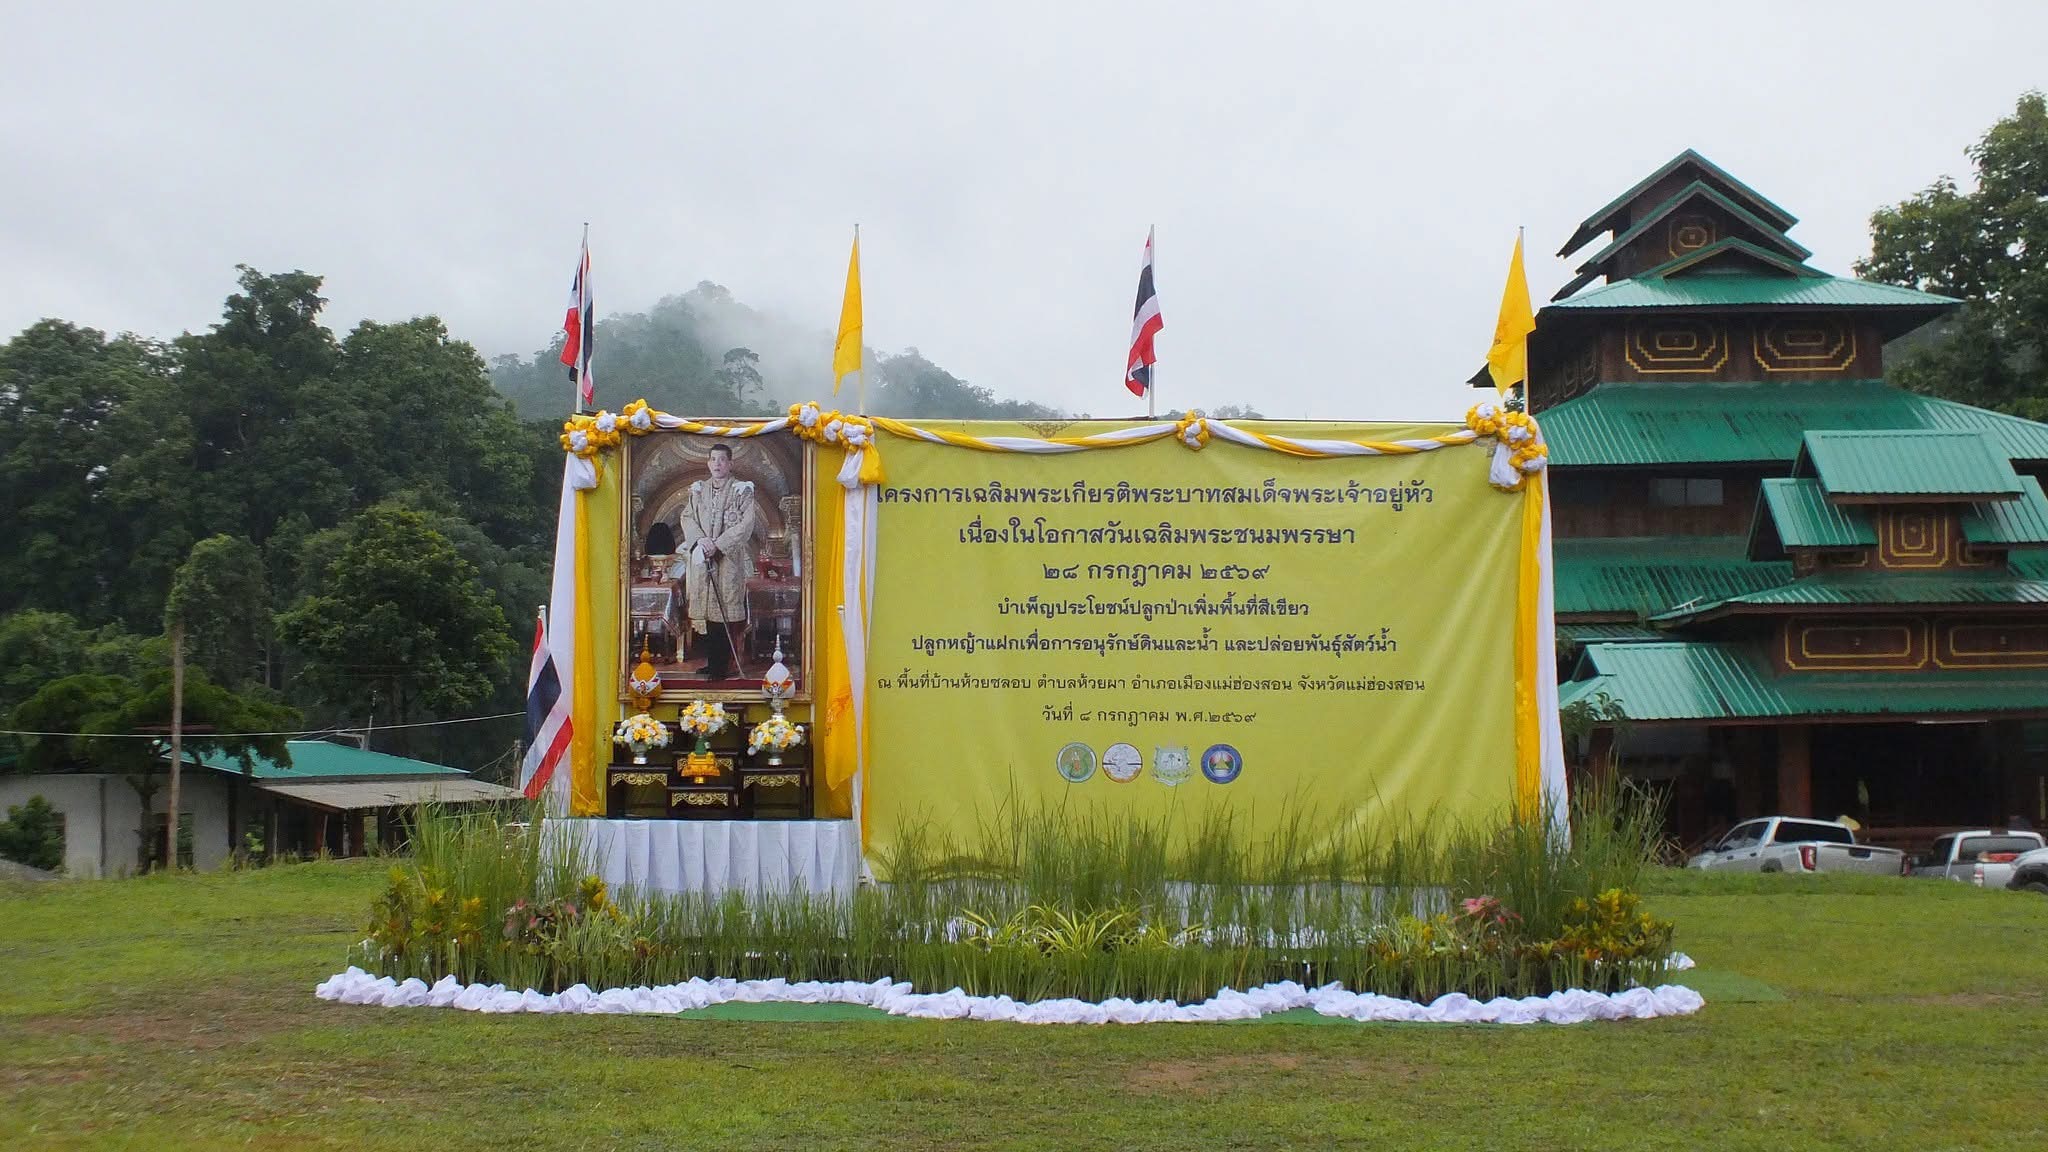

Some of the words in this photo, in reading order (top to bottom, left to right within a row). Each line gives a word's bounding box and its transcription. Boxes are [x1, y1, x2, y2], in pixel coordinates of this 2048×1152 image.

[959, 514, 1355, 545] เนื่องในโอกาสวันเฉลิมพระชนมพรรษา
[1042, 563, 1080, 580] ๒๘
[1087, 563, 1192, 588] กรกฎาคม
[1199, 563, 1271, 581] ๒๕๖๙
[997, 591, 1310, 622] บำเพ็ญประโยชน์ปลูกป่าเพิ่มพื้นที่สีเขียว
[911, 626, 1219, 658] ปลูกหญ้าแฝกเพื่อการอนุรักษ์ดินและน้ำ
[1224, 627, 1397, 659] และปล่อยพันธุ์สัตว์น้ำ
[877, 678, 892, 689] ณ
[1037, 672, 1126, 690] ตำบลห้วยผา
[1131, 673, 1293, 691] อำเภอเมืองแม่ฮ่องสอน
[1297, 674, 1426, 691] จังหวัดแม่ฮ่องสอน
[1041, 700, 1073, 722] วันที่
[1079, 710, 1092, 722] ๘
[1097, 710, 1170, 728] กรกฎาคม
[1175, 711, 1257, 723] พ.ศ.๒๕๖๙
